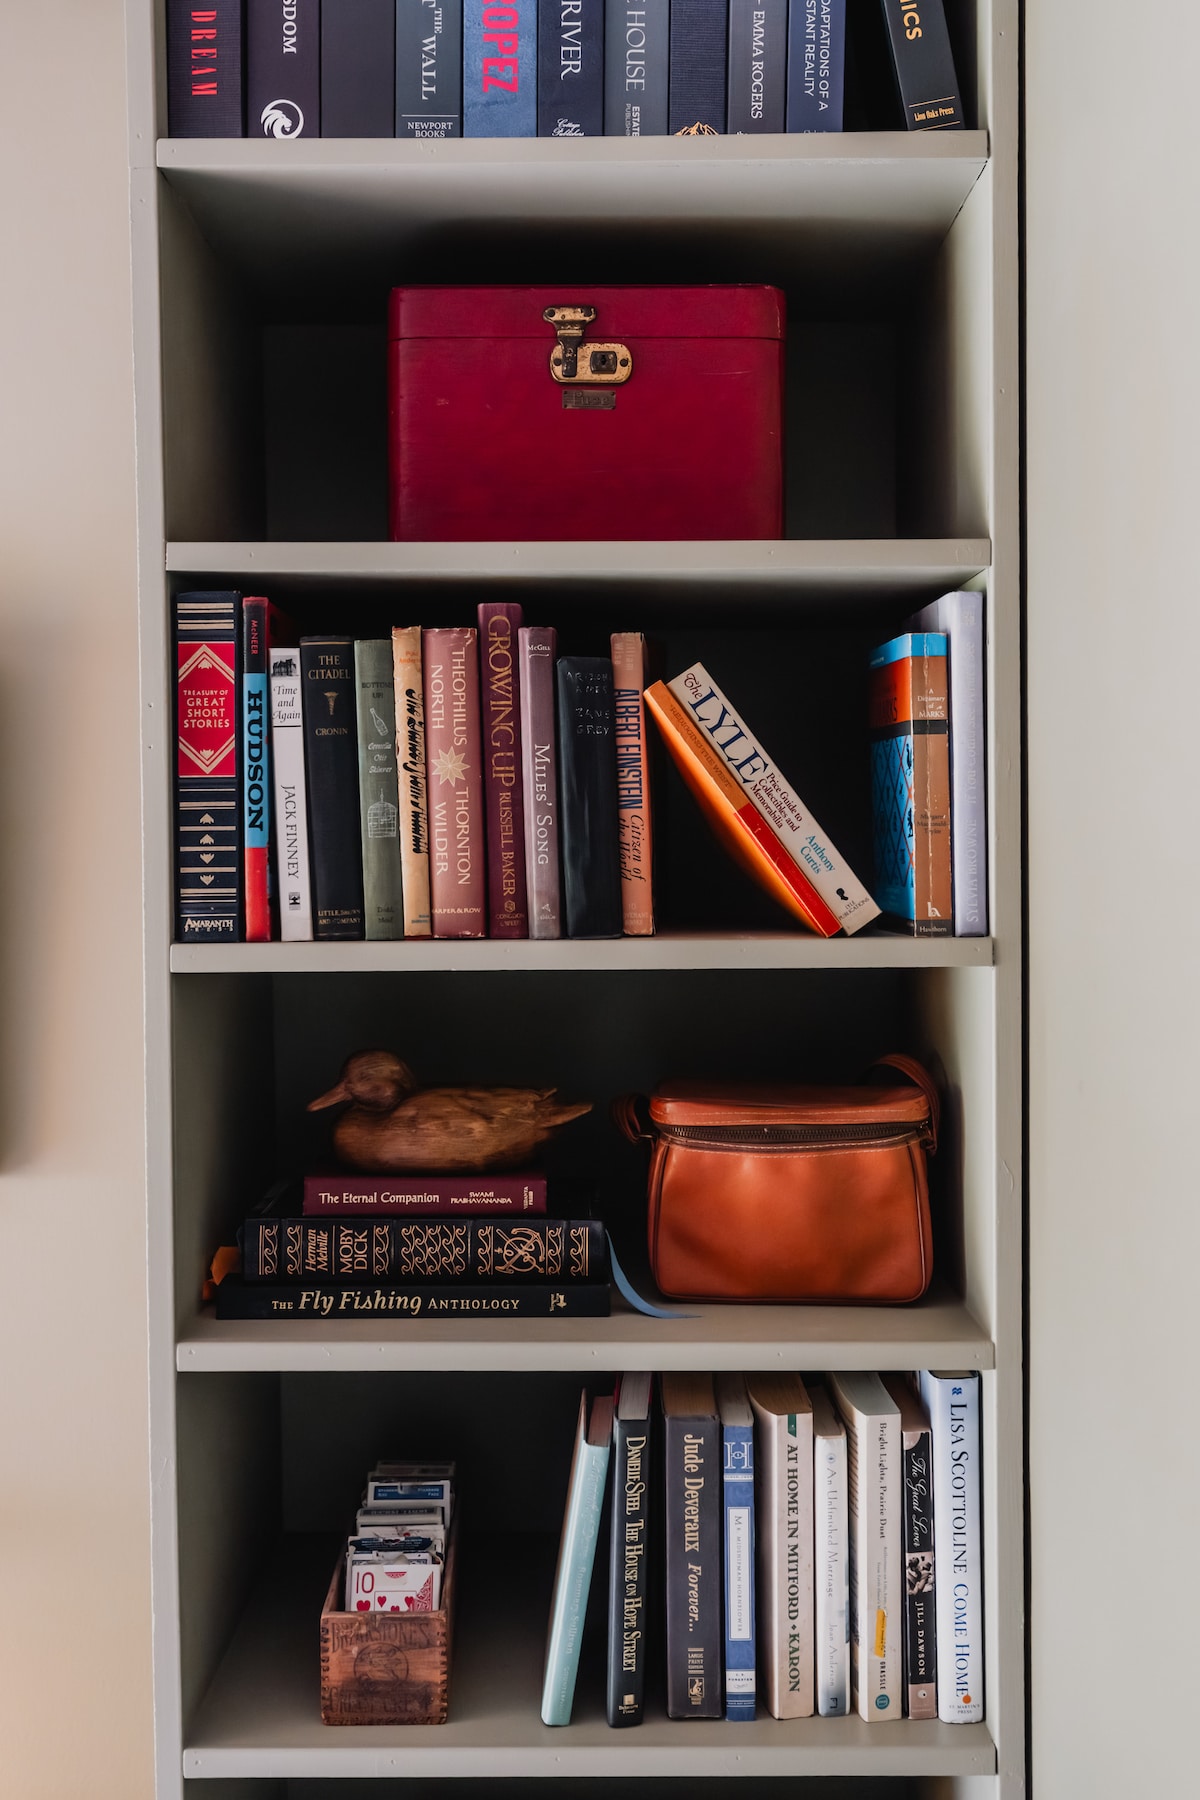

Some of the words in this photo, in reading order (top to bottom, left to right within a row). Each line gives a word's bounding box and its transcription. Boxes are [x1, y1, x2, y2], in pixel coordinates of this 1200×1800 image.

[433, 8, 442, 34] THE
[560, 0, 583, 80] RIVER
[752, 10, 766, 57] EMMA
[898, 0, 922, 41] ICS
[191, 10, 217, 96] DREAM
[482, 0, 519, 93] OPEZ
[625, 10, 645, 91] HOUSE
[421, 35, 437, 100] WALL
[803, 44, 815, 96] REALITY
[751, 61, 764, 119] ROGERS
[818, 101, 828, 111] A
[819, 79, 829, 98] OF
[407, 122, 453, 130] NEWPORT
[939, 107, 955, 117] Press
[308, 669, 350, 680] CITADEL
[318, 655, 340, 666] THE
[488, 615, 514, 746] GROWING
[186, 698, 225, 706] GREAT
[274, 685, 298, 695] Time
[277, 697, 294, 707] and
[431, 665, 445, 729] NORTH
[451, 648, 468, 746] THEOPHILUS
[684, 672, 703, 700] The
[183, 719, 230, 728] STORIES
[187, 708, 225, 717] SHORT
[272, 711, 300, 723] Again
[315, 727, 348, 736] CRONIN
[576, 724, 610, 735] GREY
[614, 689, 640, 741] ALBERT
[688, 686, 769, 784] LYLE
[246, 690, 263, 831] HUDSON
[490, 752, 515, 787] UP
[617, 745, 643, 810] EINSTEIN
[281, 785, 296, 818] JACK
[750, 783, 784, 829] Memorabilia
[758, 778, 788, 819] Collectibles
[786, 816, 800, 833] and
[766, 772, 783, 792] Price
[780, 786, 798, 814] Guide
[796, 812, 803, 822] to
[434, 802, 449, 876] WILDER
[455, 786, 471, 885] THORNTON
[499, 791, 513, 848] RUSSELL
[536, 814, 553, 865] SONG
[628, 814, 645, 861] Citizen
[285, 821, 299, 879] FINNEY
[800, 846, 821, 875] Curtis
[805, 834, 836, 873] Anthony
[966, 819, 977, 875] BROWNE
[500, 851, 516, 897] BAKER
[635, 866, 646, 881] of
[966, 878, 978, 922] SYLVIA
[318, 1192, 339, 1204] The
[342, 1192, 377, 1204] Eternal
[380, 1192, 440, 1205] Companion
[305, 1228, 317, 1272] Herman
[317, 1230, 328, 1272] Melville
[340, 1226, 353, 1273] MOBY
[354, 1229, 368, 1270] DICK
[272, 1300, 293, 1309] THE
[299, 1290, 334, 1315] Fly
[338, 1290, 422, 1315] Fishing
[428, 1299, 520, 1310] ANTHOLOGY
[879, 1422, 887, 1451] Bright
[950, 1403, 967, 1444] LISA
[625, 1435, 646, 1483] DANIELLE
[683, 1434, 704, 1472] Jude
[724, 1441, 753, 1469] H
[787, 1444, 798, 1463] AT
[878, 1453, 887, 1484] Lights,
[911, 1453, 927, 1478] The
[787, 1466, 798, 1516] HOME
[827, 1467, 839, 1486] An
[906, 1479, 928, 1511] Great
[626, 1482, 645, 1515] STEEL
[684, 1477, 705, 1553] Deveraux
[826, 1490, 838, 1546] Unfinished
[878, 1486, 887, 1516] Prairie
[950, 1450, 969, 1574] SCOTTOLINE
[626, 1519, 644, 1542] THE
[787, 1519, 798, 1538] IN
[878, 1518, 887, 1539] Dust
[912, 1514, 928, 1548] Lover
[355, 1571, 375, 1594] 10
[625, 1544, 643, 1581] HOUSE
[787, 1545, 799, 1621] MITFORD
[824, 1550, 838, 1598] Marriage
[627, 1583, 637, 1593] ON
[687, 1562, 702, 1633] Forever...
[624, 1595, 642, 1628] HOPE
[914, 1601, 925, 1625] JILL
[953, 1583, 969, 1637] COME
[567, 1614, 580, 1654] Sullivan
[622, 1630, 641, 1673] STREET
[827, 1624, 838, 1643] Joan
[914, 1630, 925, 1676] DAWSON
[788, 1632, 801, 1692] KARON
[827, 1645, 838, 1687] Anderson
[954, 1643, 971, 1698] HOME
